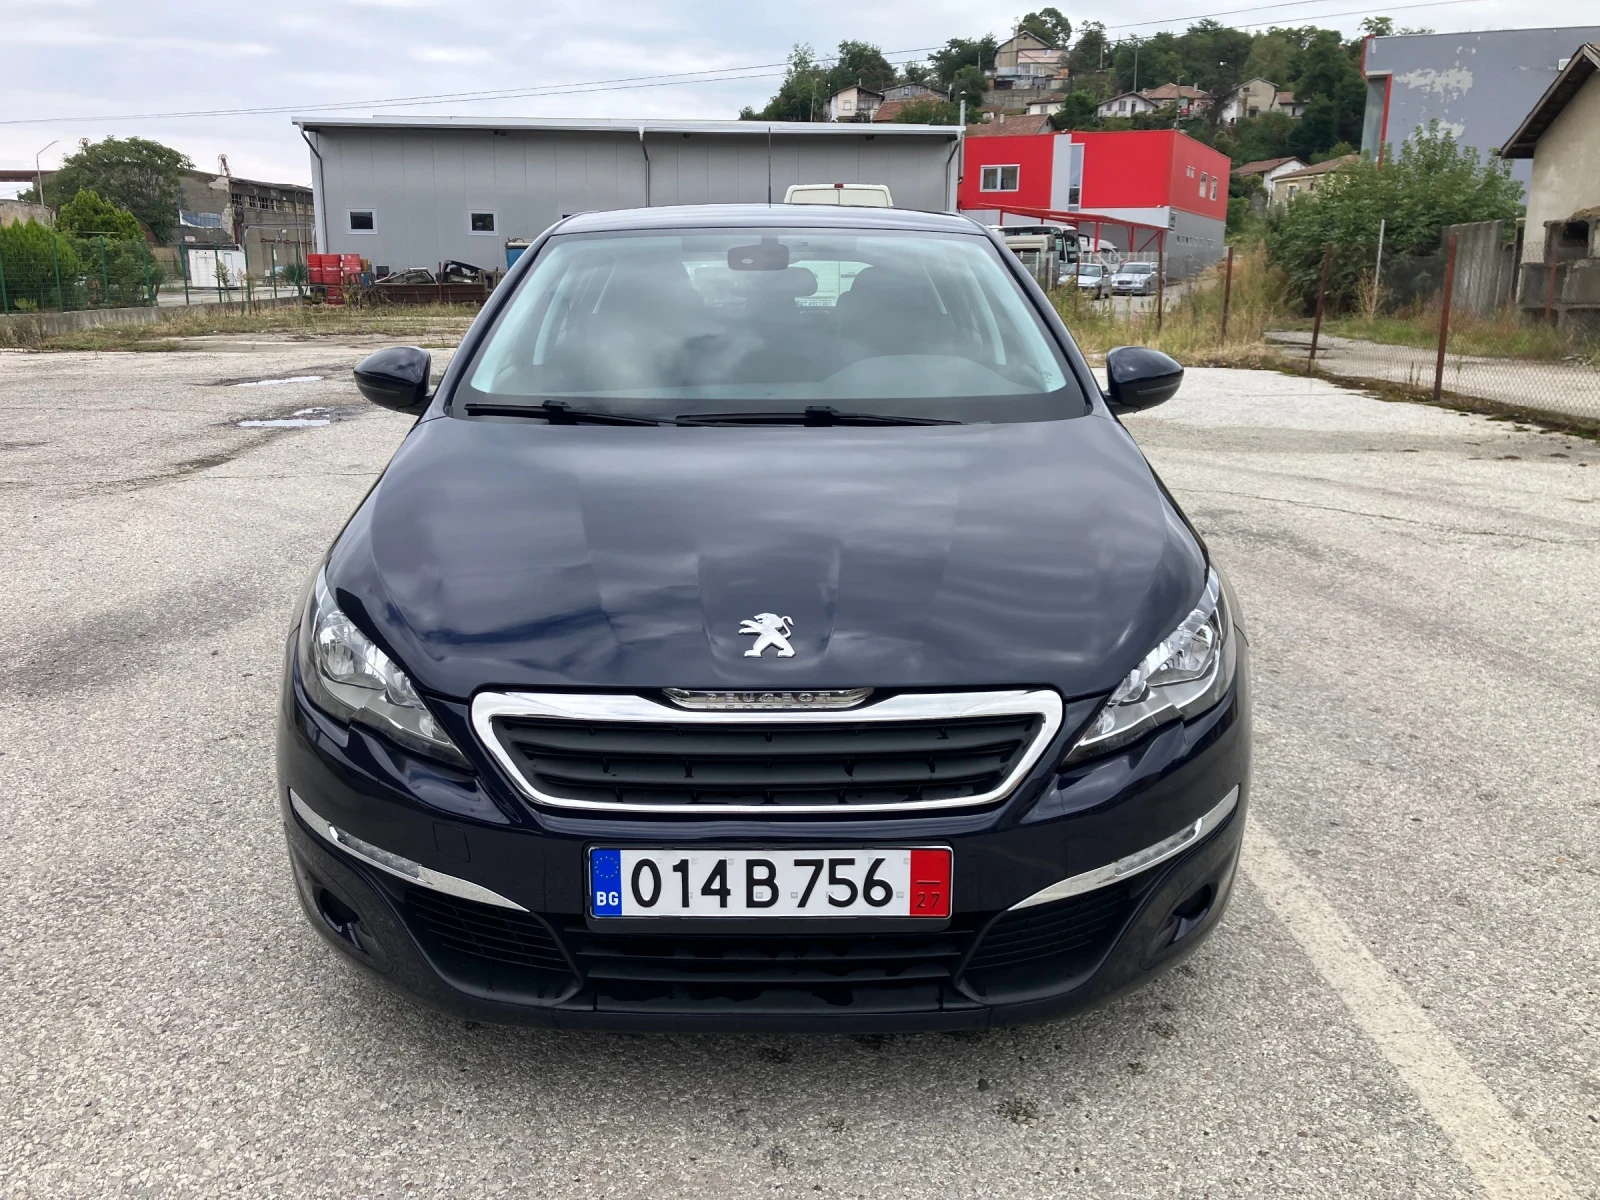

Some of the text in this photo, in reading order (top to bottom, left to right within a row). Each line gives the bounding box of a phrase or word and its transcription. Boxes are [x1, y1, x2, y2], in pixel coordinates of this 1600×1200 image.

[706, 692, 831, 703] PEUGEOT
[596, 891, 619, 906] BG
[916, 892, 940, 908] 27
